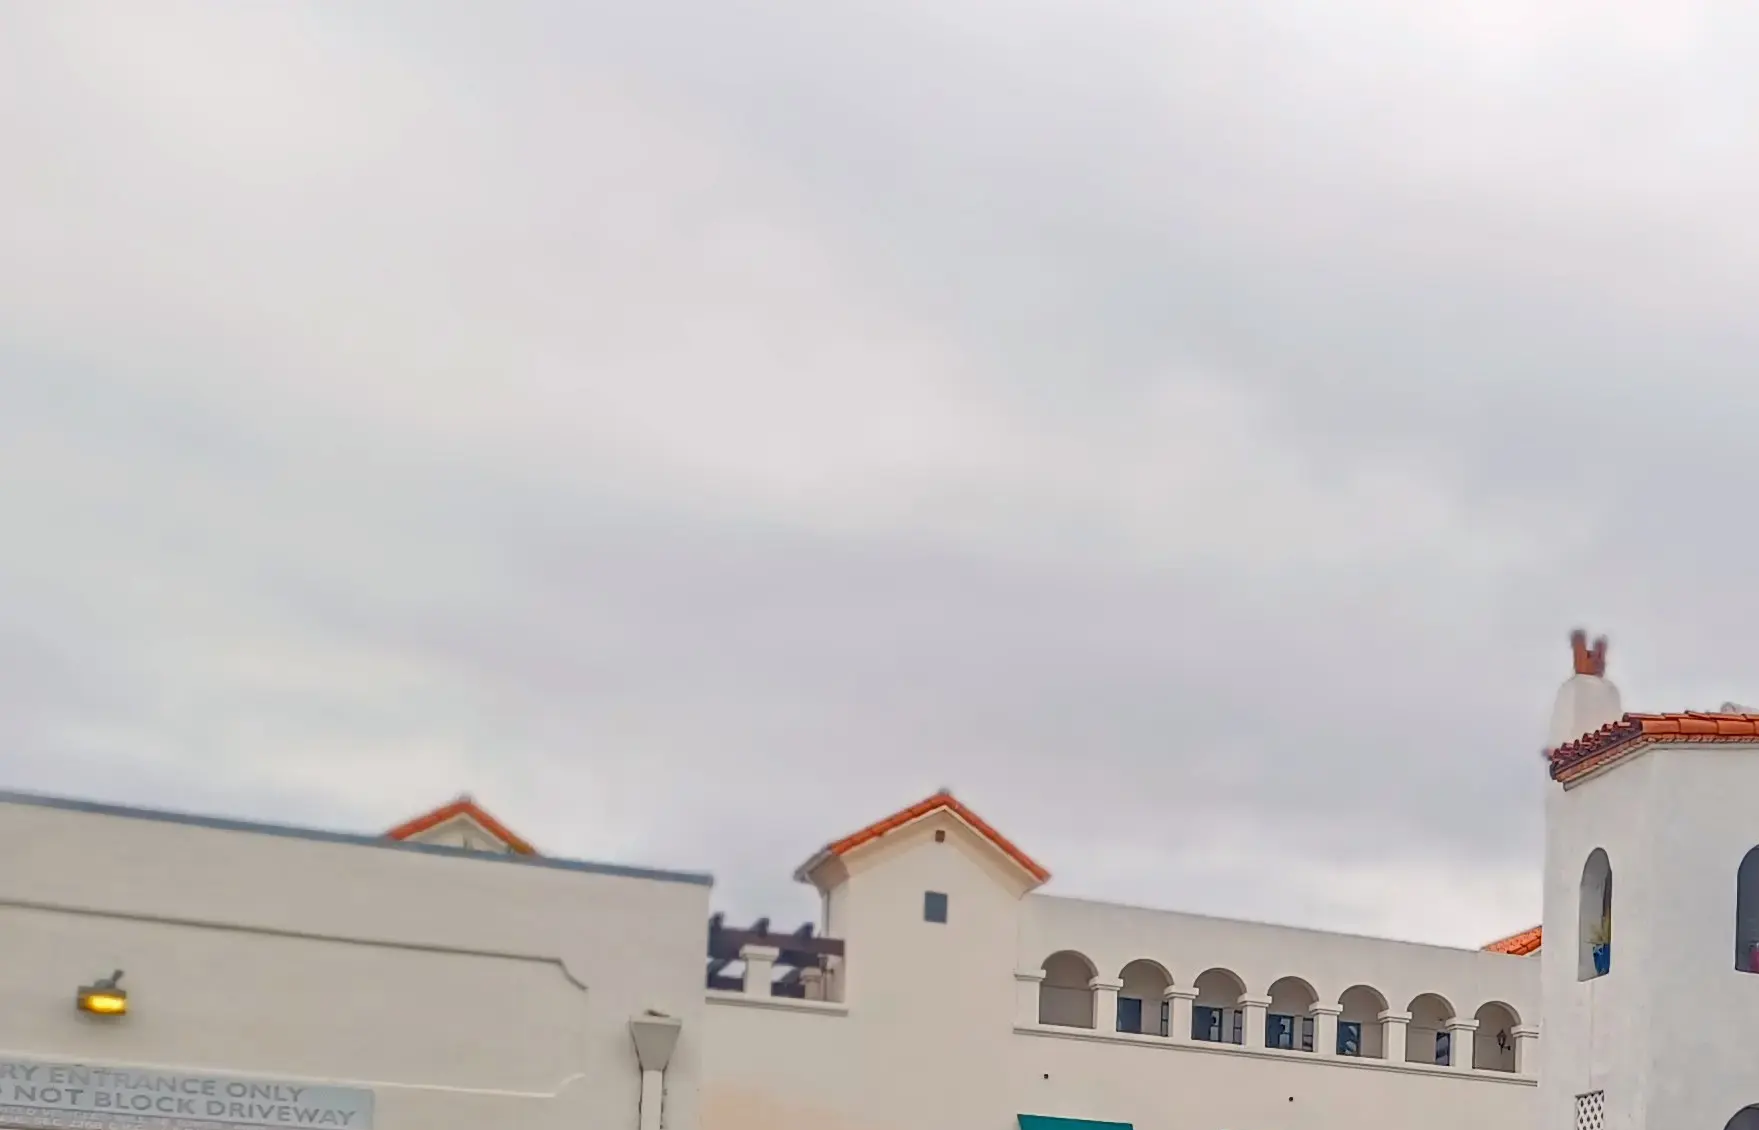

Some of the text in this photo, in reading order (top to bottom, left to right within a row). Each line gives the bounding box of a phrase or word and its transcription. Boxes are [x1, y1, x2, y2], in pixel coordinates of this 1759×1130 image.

[48, 1066, 217, 1096] ENTRANCE
[225, 1081, 308, 1102] ONLY
[13, 1084, 84, 1106] NOT
[94, 1091, 196, 1115] BLOCK
[206, 1100, 357, 1126] DRIVEWAY
